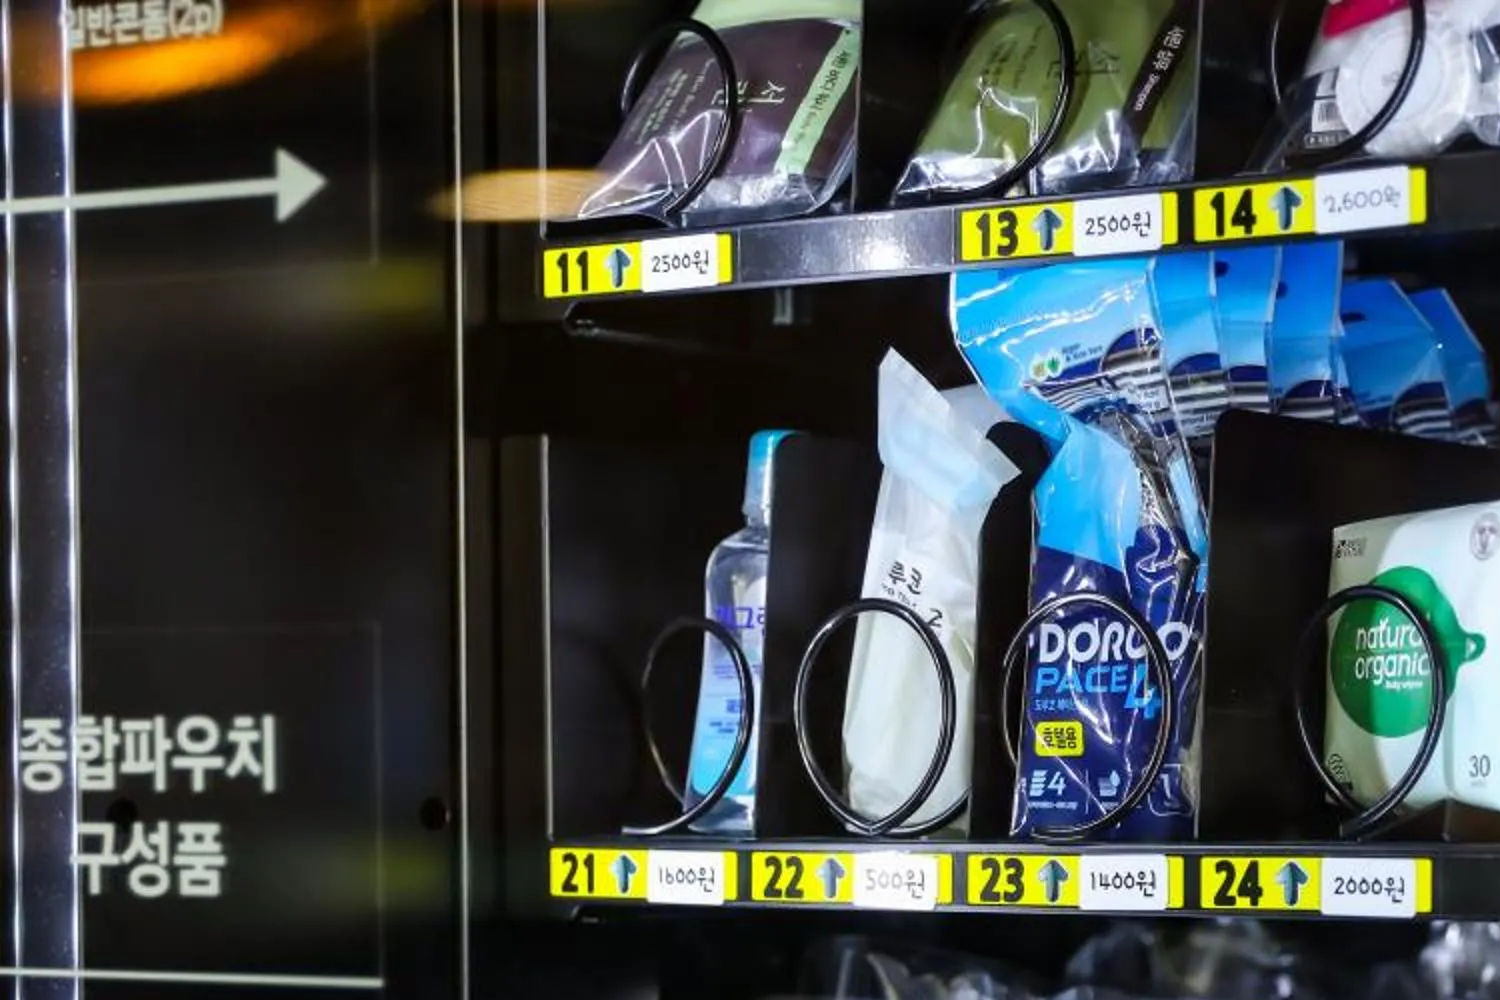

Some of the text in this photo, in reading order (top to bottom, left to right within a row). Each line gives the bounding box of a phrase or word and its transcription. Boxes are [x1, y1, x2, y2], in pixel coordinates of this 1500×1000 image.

[1210, 189, 1256, 237] 14
[1323, 184, 1401, 213] 2,600원
[976, 211, 1019, 257] 13
[1085, 212, 1151, 237] 2500원
[557, 252, 588, 293] 11
[651, 250, 709, 275] 2500원
[1356, 617, 1423, 651] natura
[1035, 664, 1129, 694] PACE
[1355, 652, 1431, 686] organic
[20, 714, 277, 793] 종합파우치
[1468, 754, 1491, 778] 30
[1047, 771, 1066, 796] 4
[70, 820, 227, 898] 구성품
[561, 852, 595, 893] 21
[658, 866, 715, 893] 1600원
[764, 856, 804, 899] 22
[865, 869, 925, 899] 500원
[980, 857, 1025, 902] 23
[1090, 869, 1156, 897] 1400원
[1213, 860, 1263, 907] 24
[1334, 876, 1405, 903] 2000원
